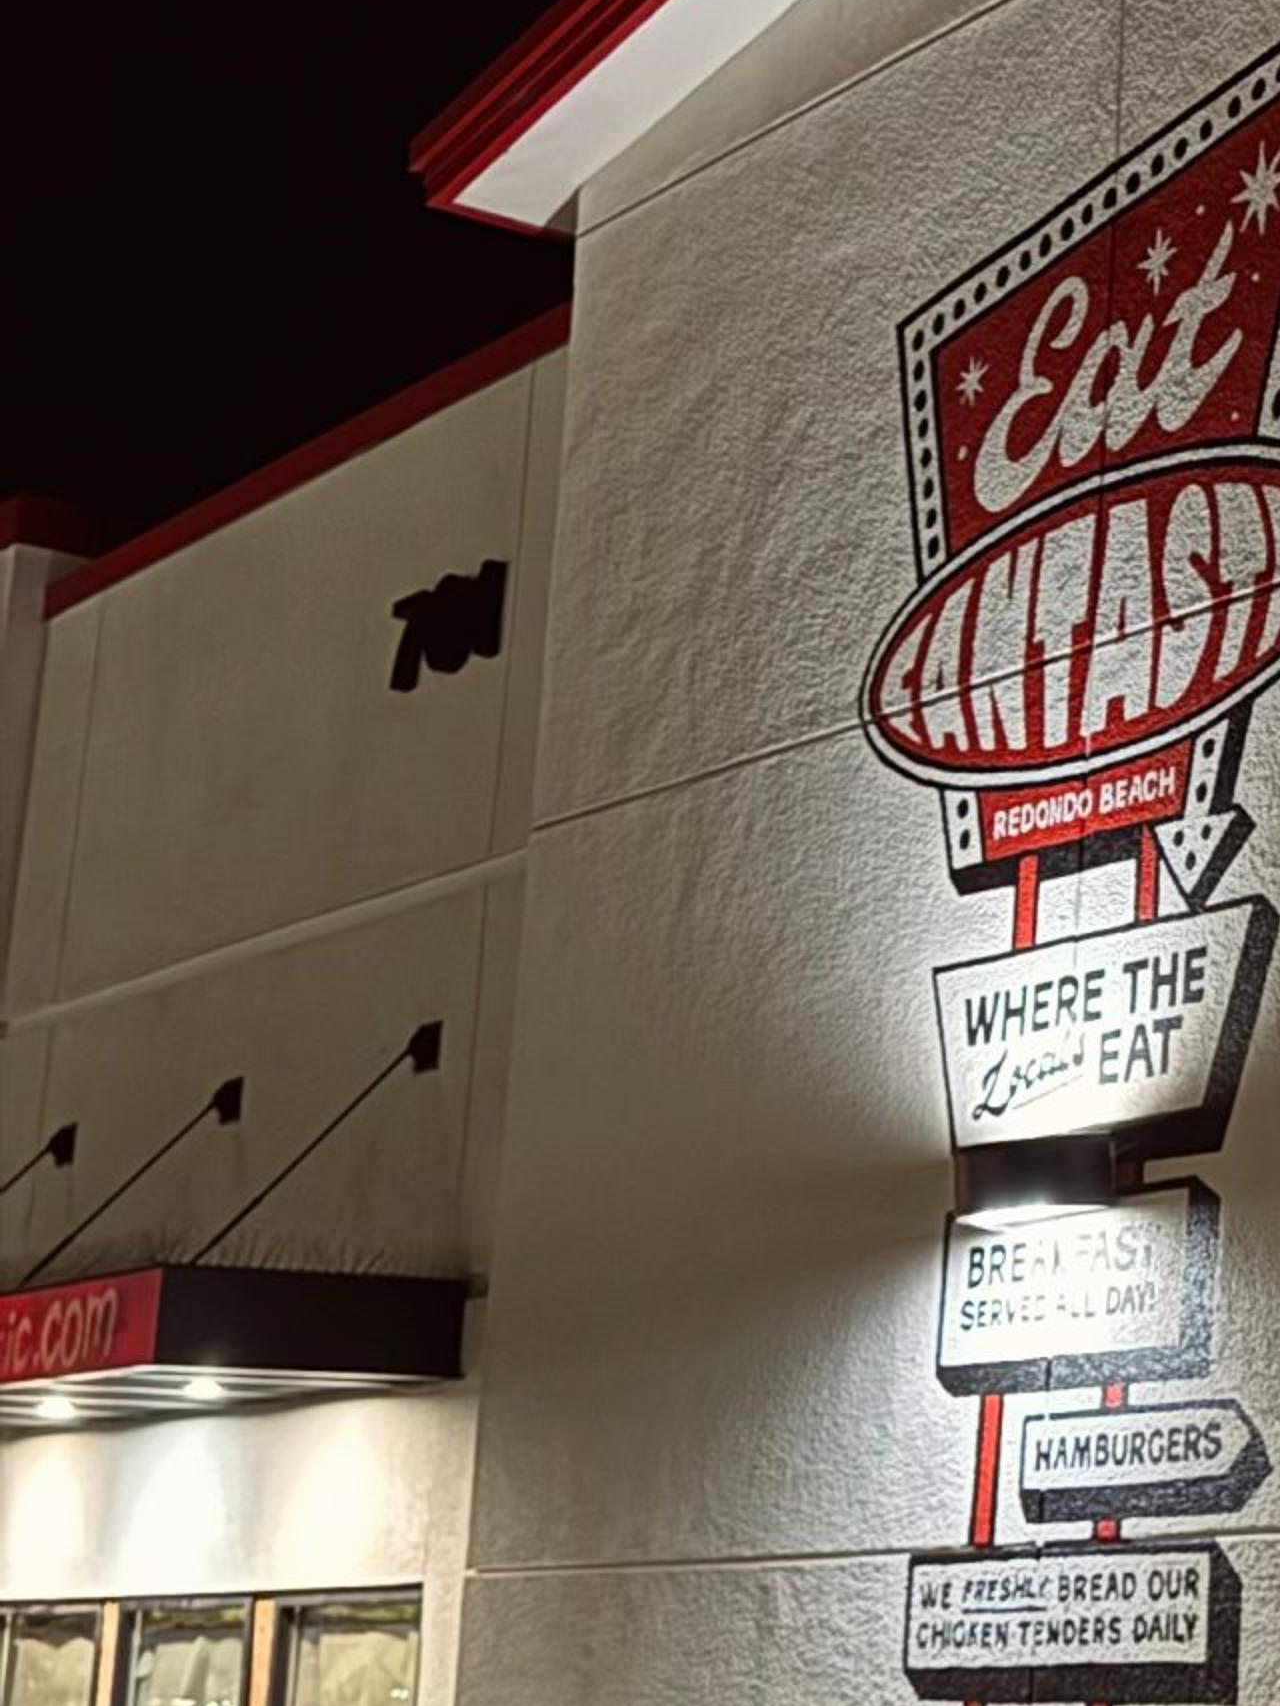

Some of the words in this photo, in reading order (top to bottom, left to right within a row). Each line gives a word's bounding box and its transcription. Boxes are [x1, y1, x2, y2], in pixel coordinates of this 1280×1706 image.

[974, 220, 1243, 512] Eat
[992, 789, 1094, 841] REDONDO
[1099, 765, 1177, 815] BEACH
[965, 968, 1106, 1047] WHERE
[1122, 945, 1208, 1014] THE
[1099, 1014, 1184, 1086] EAT
[0, 1287, 118, 1376] ic.com
[1035, 1422, 1223, 1472] HAMBURGERS
[919, 1582, 951, 1610] WE
[961, 1570, 1053, 1604] FRESHLY
[1057, 1572, 1137, 1602] BREAD
[1147, 1568, 1201, 1601] OUR
[915, 1620, 1010, 1649] CHICKEN
[1018, 1617, 1122, 1647] TENDERS
[1132, 1613, 1199, 1643] DAILY
